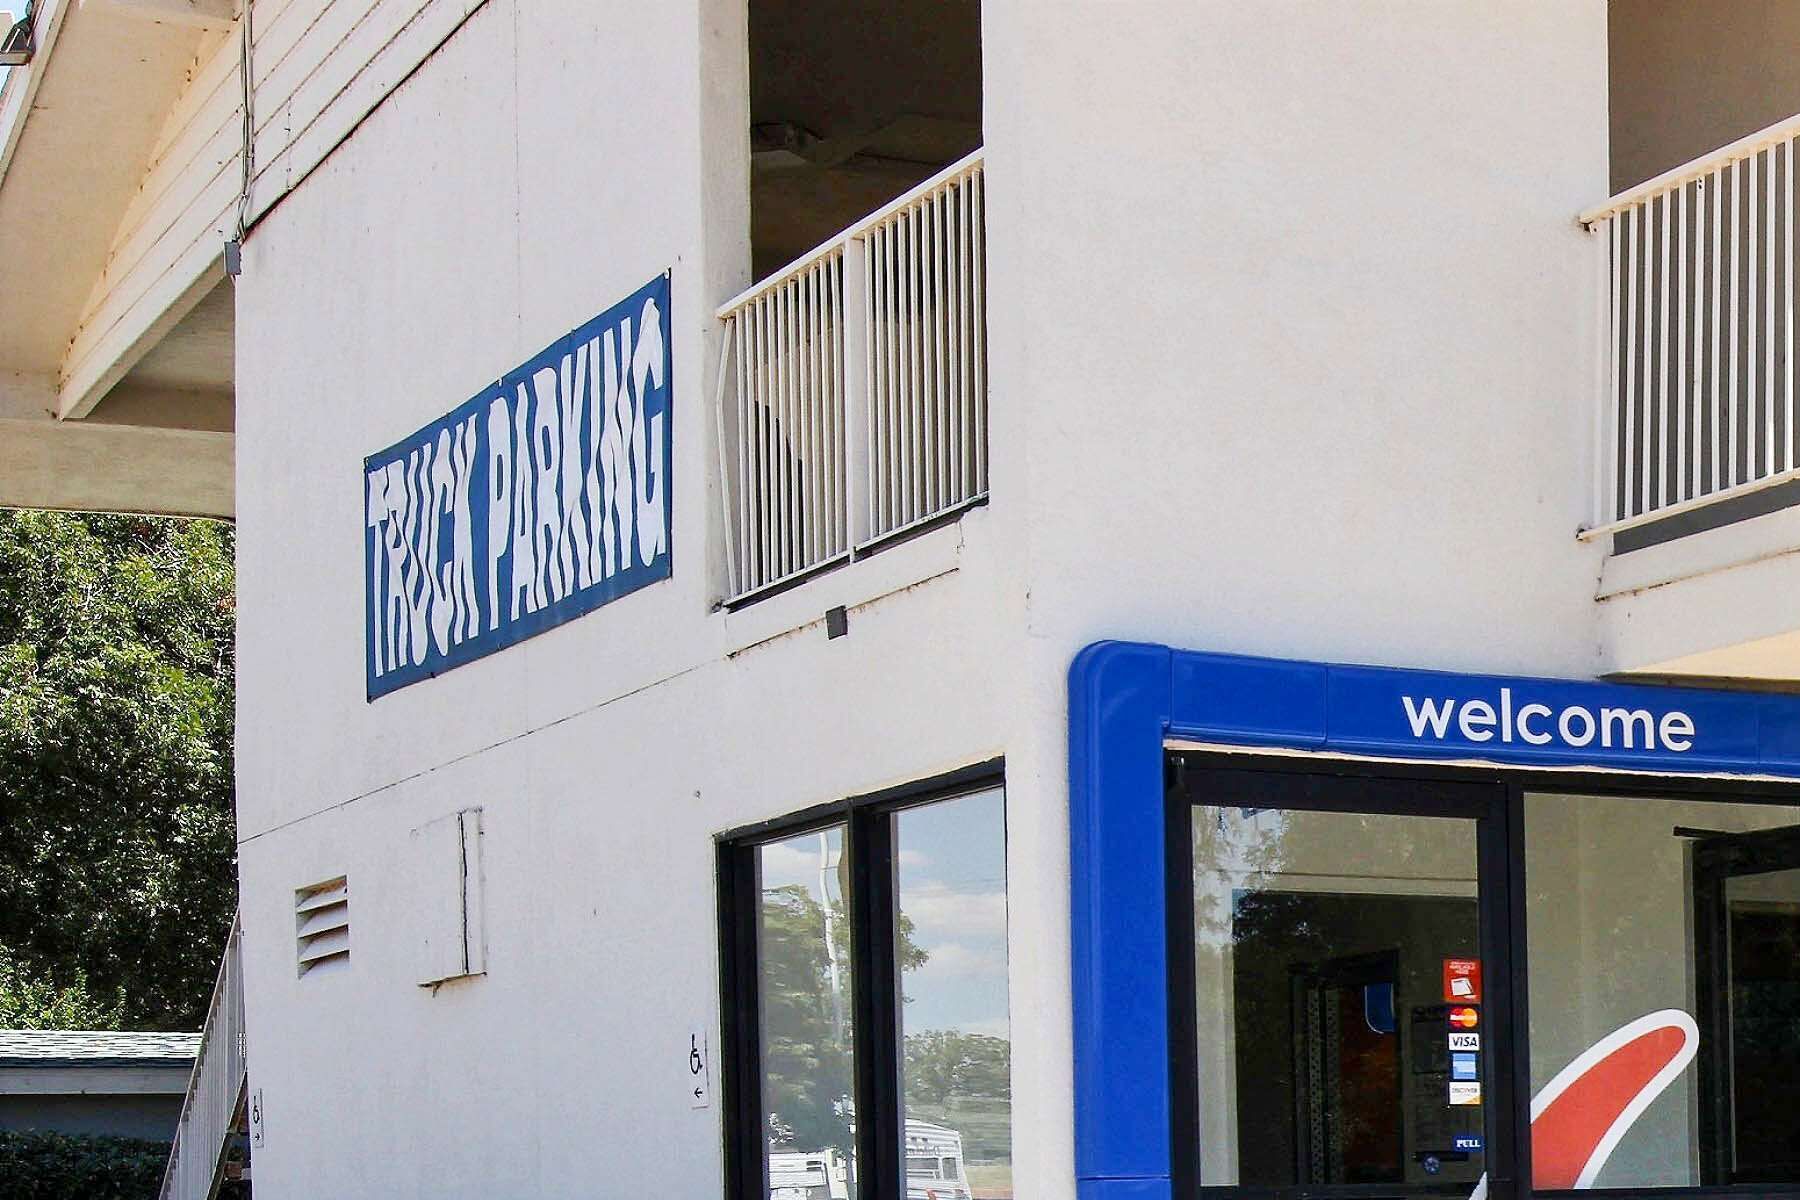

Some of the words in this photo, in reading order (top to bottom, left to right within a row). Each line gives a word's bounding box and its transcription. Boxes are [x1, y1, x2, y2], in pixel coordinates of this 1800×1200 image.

[368, 413, 479, 677] TRUCK
[488, 297, 666, 630] PARKING
[1401, 688, 1696, 751] welcome
[1452, 1036, 1478, 1047] VISA
[1456, 1139, 1481, 1148] PULL
